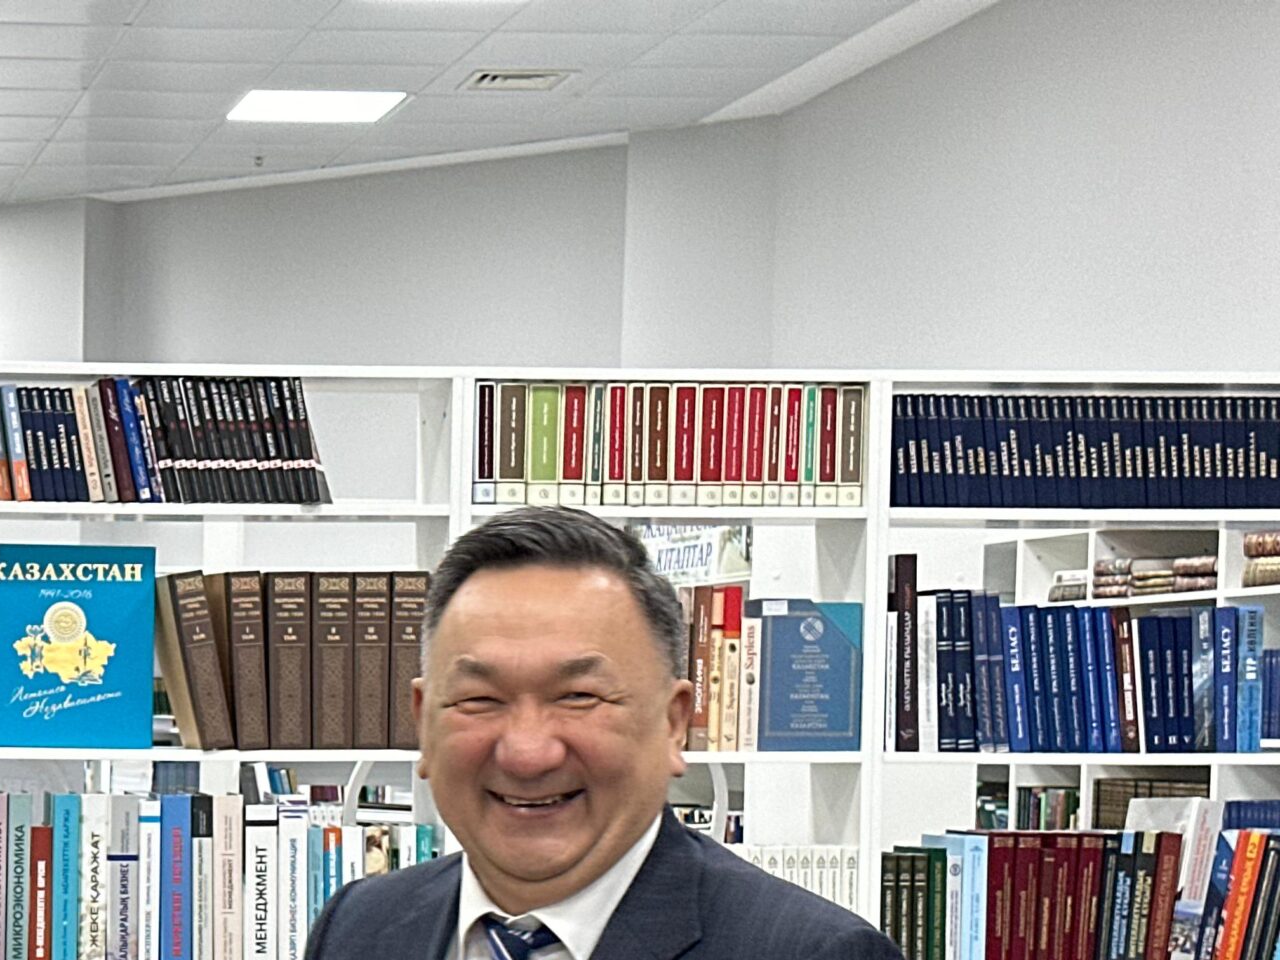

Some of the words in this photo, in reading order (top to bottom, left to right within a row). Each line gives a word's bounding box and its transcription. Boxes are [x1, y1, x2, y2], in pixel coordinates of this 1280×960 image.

[655, 542, 713, 572] КІТАПТАР
[744, 625, 757, 670] Sapiens
[90, 831, 101, 903] ҚАРАЖАТ
[119, 863, 128, 895] БИЗНЕС
[12, 824, 25, 959] МИКРОЭКОНОМИКА
[255, 845, 268, 954] МЕНЕДЖМЕНТ
[89, 907, 99, 948] ЖЕКЕ
